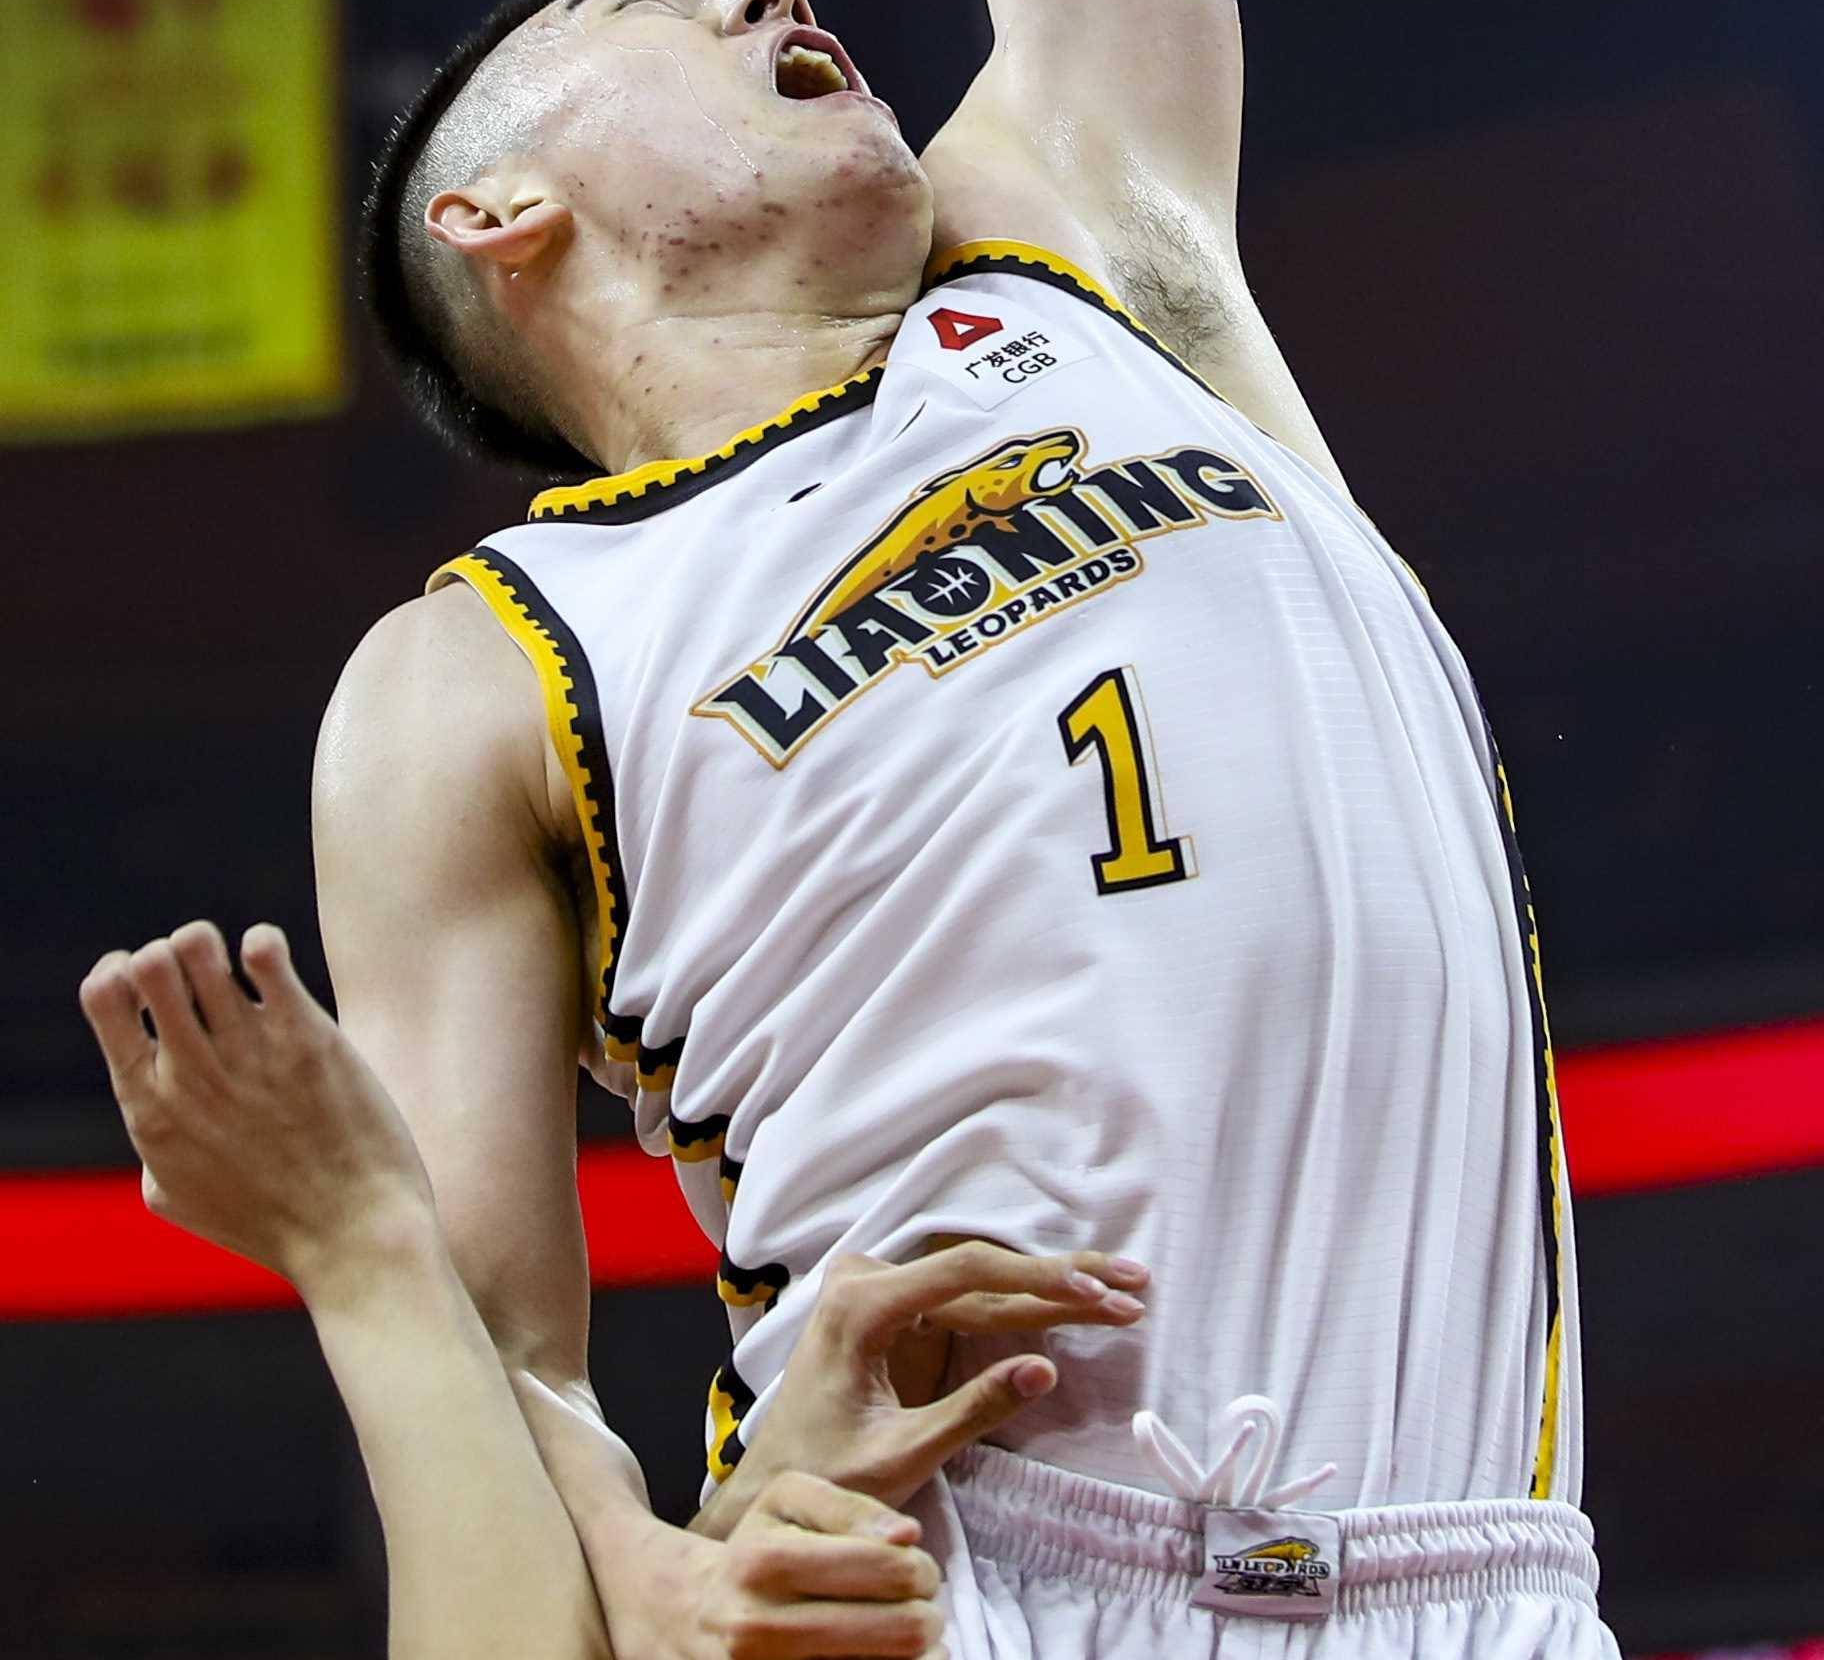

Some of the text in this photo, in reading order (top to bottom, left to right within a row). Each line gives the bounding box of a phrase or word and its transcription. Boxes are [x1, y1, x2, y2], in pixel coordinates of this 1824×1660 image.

[964, 330, 1051, 380] 广发银行
[1002, 352, 1057, 384] CGB
[698, 449, 1282, 762] LIAONING
[922, 547, 1137, 667] LEOPARDS
[1057, 665, 1192, 896] 1
